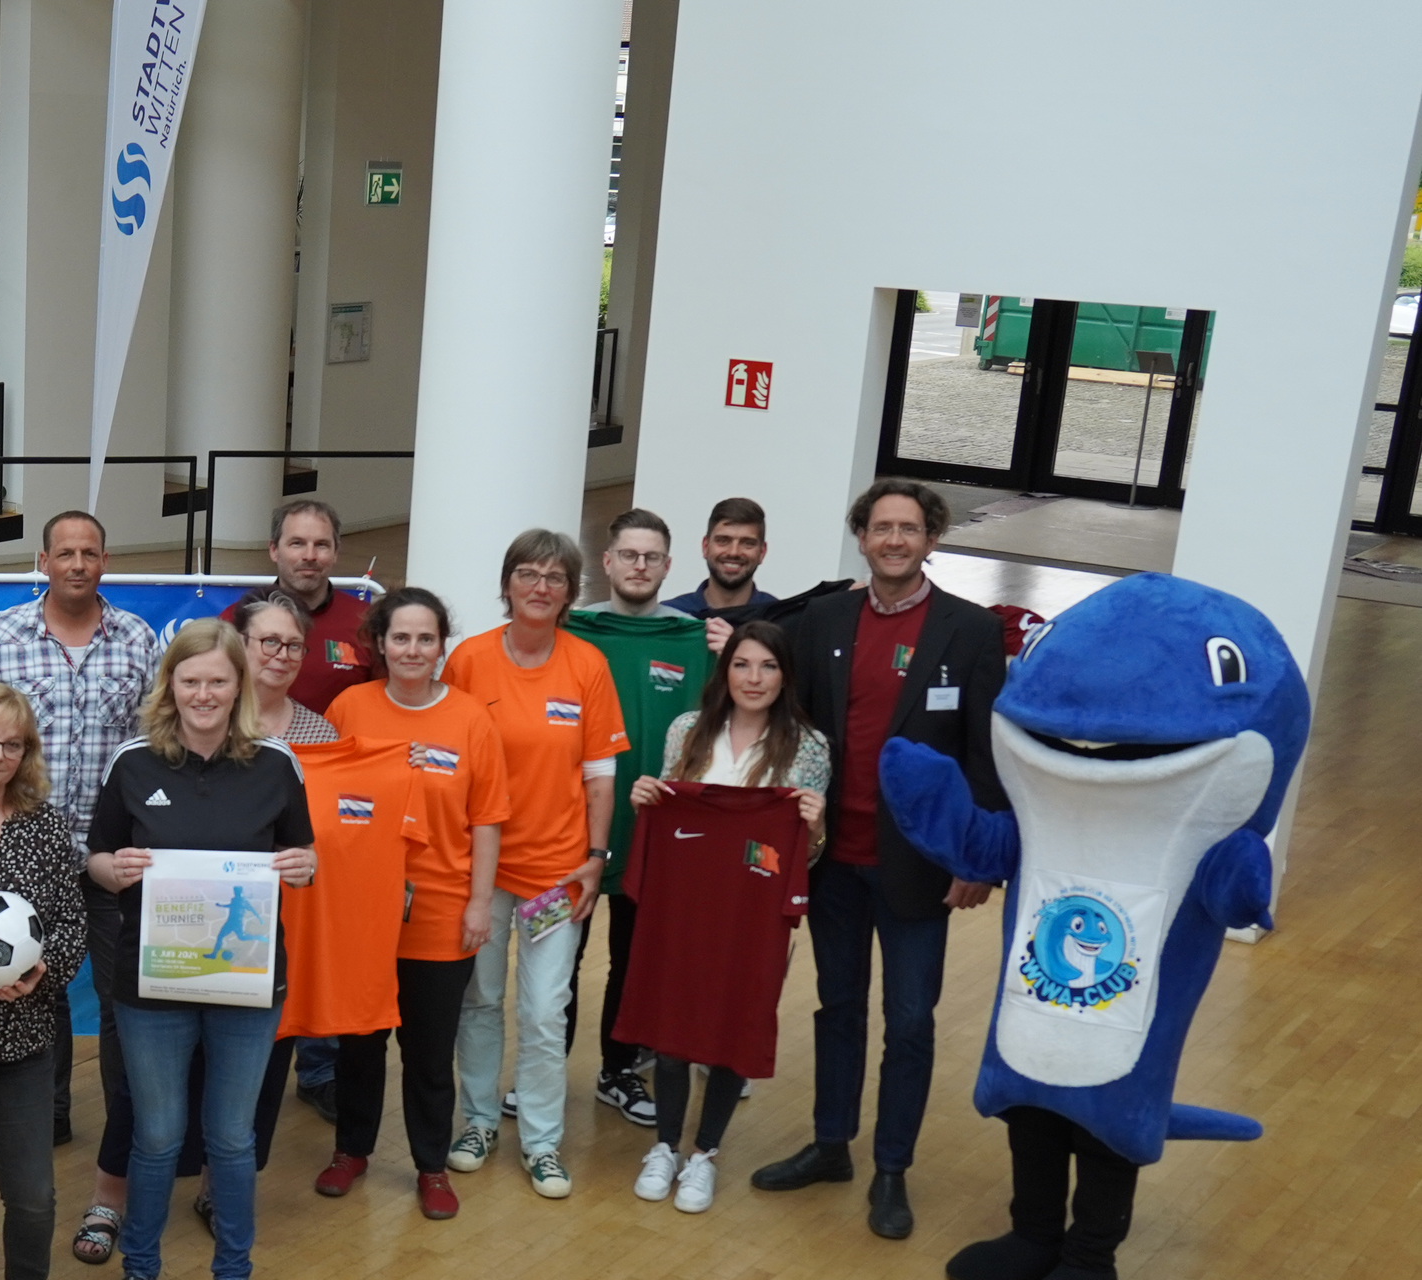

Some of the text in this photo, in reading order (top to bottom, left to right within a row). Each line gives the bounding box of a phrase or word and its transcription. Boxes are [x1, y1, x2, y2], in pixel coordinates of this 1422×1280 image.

[133, 0, 170, 127] STADT
[145, 5, 185, 134] WITTEN
[160, 60, 187, 149] Natürlich.
[145, 799, 172, 807] adidas
[155, 903, 204, 913] BENEFIZ
[157, 914, 204, 924] TURNIER
[1020, 957, 1137, 1007] WIWA-CLUB
